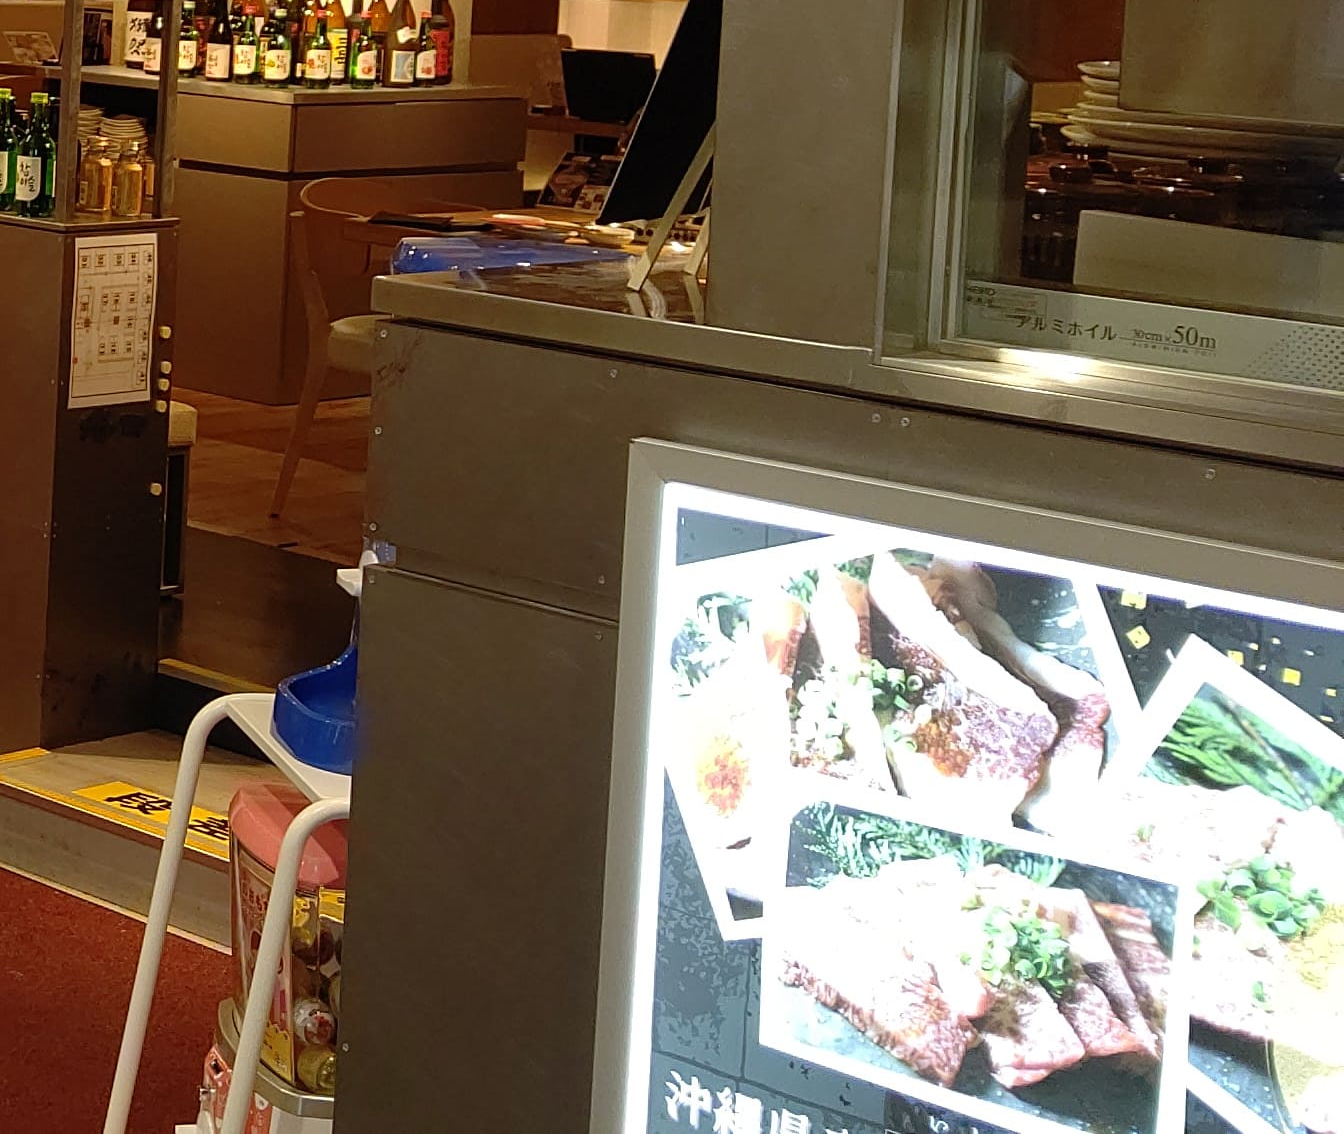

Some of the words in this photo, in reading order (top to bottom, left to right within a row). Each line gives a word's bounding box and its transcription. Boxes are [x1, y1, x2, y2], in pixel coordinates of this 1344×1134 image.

[1014, 316, 1116, 340] アルミホイル
